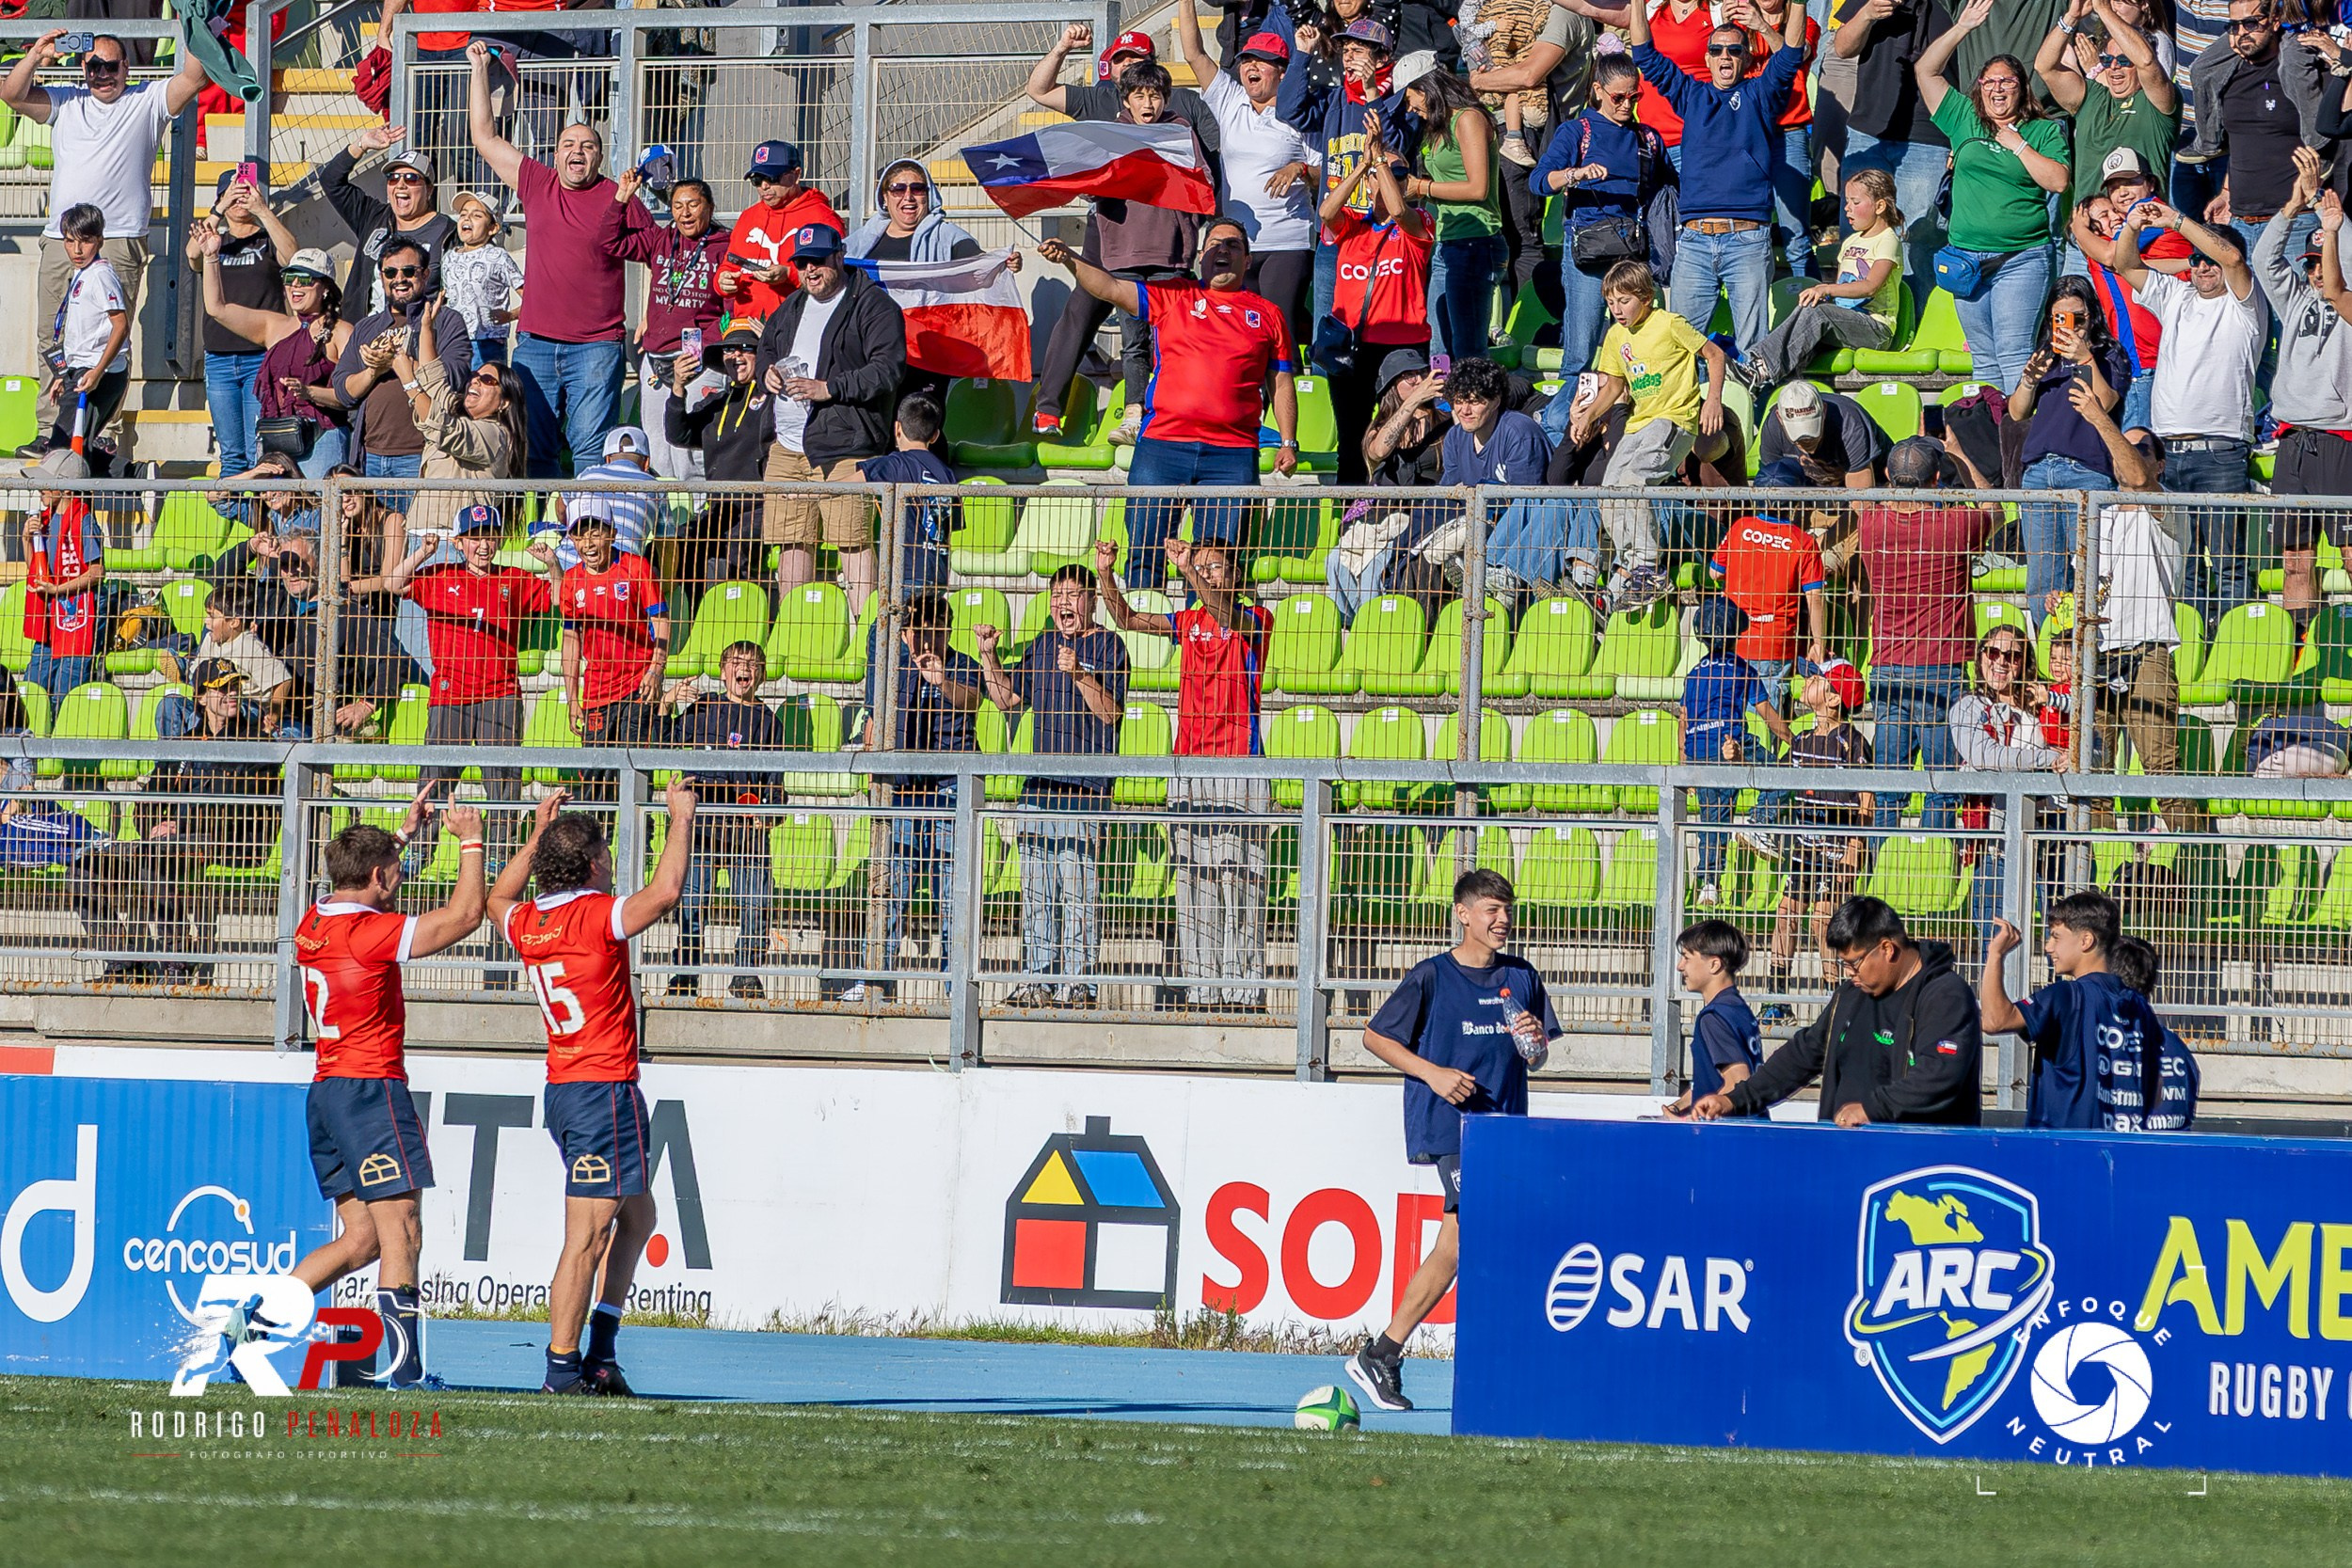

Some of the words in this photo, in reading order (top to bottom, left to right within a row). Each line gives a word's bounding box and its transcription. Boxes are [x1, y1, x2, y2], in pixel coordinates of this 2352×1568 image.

[1742, 528, 1792, 550] COPEC
[471, 608, 485, 632] 7
[300, 965, 341, 1039] 12
[528, 961, 587, 1036] 15
[1461, 1020, 1494, 1036] Banco
[123, 1229, 297, 1276] cencosud
[1872, 1247, 2022, 1318] ARC
[1606, 1252, 1752, 1334] SAR
[2208, 1361, 2334, 1421] RUGBY
